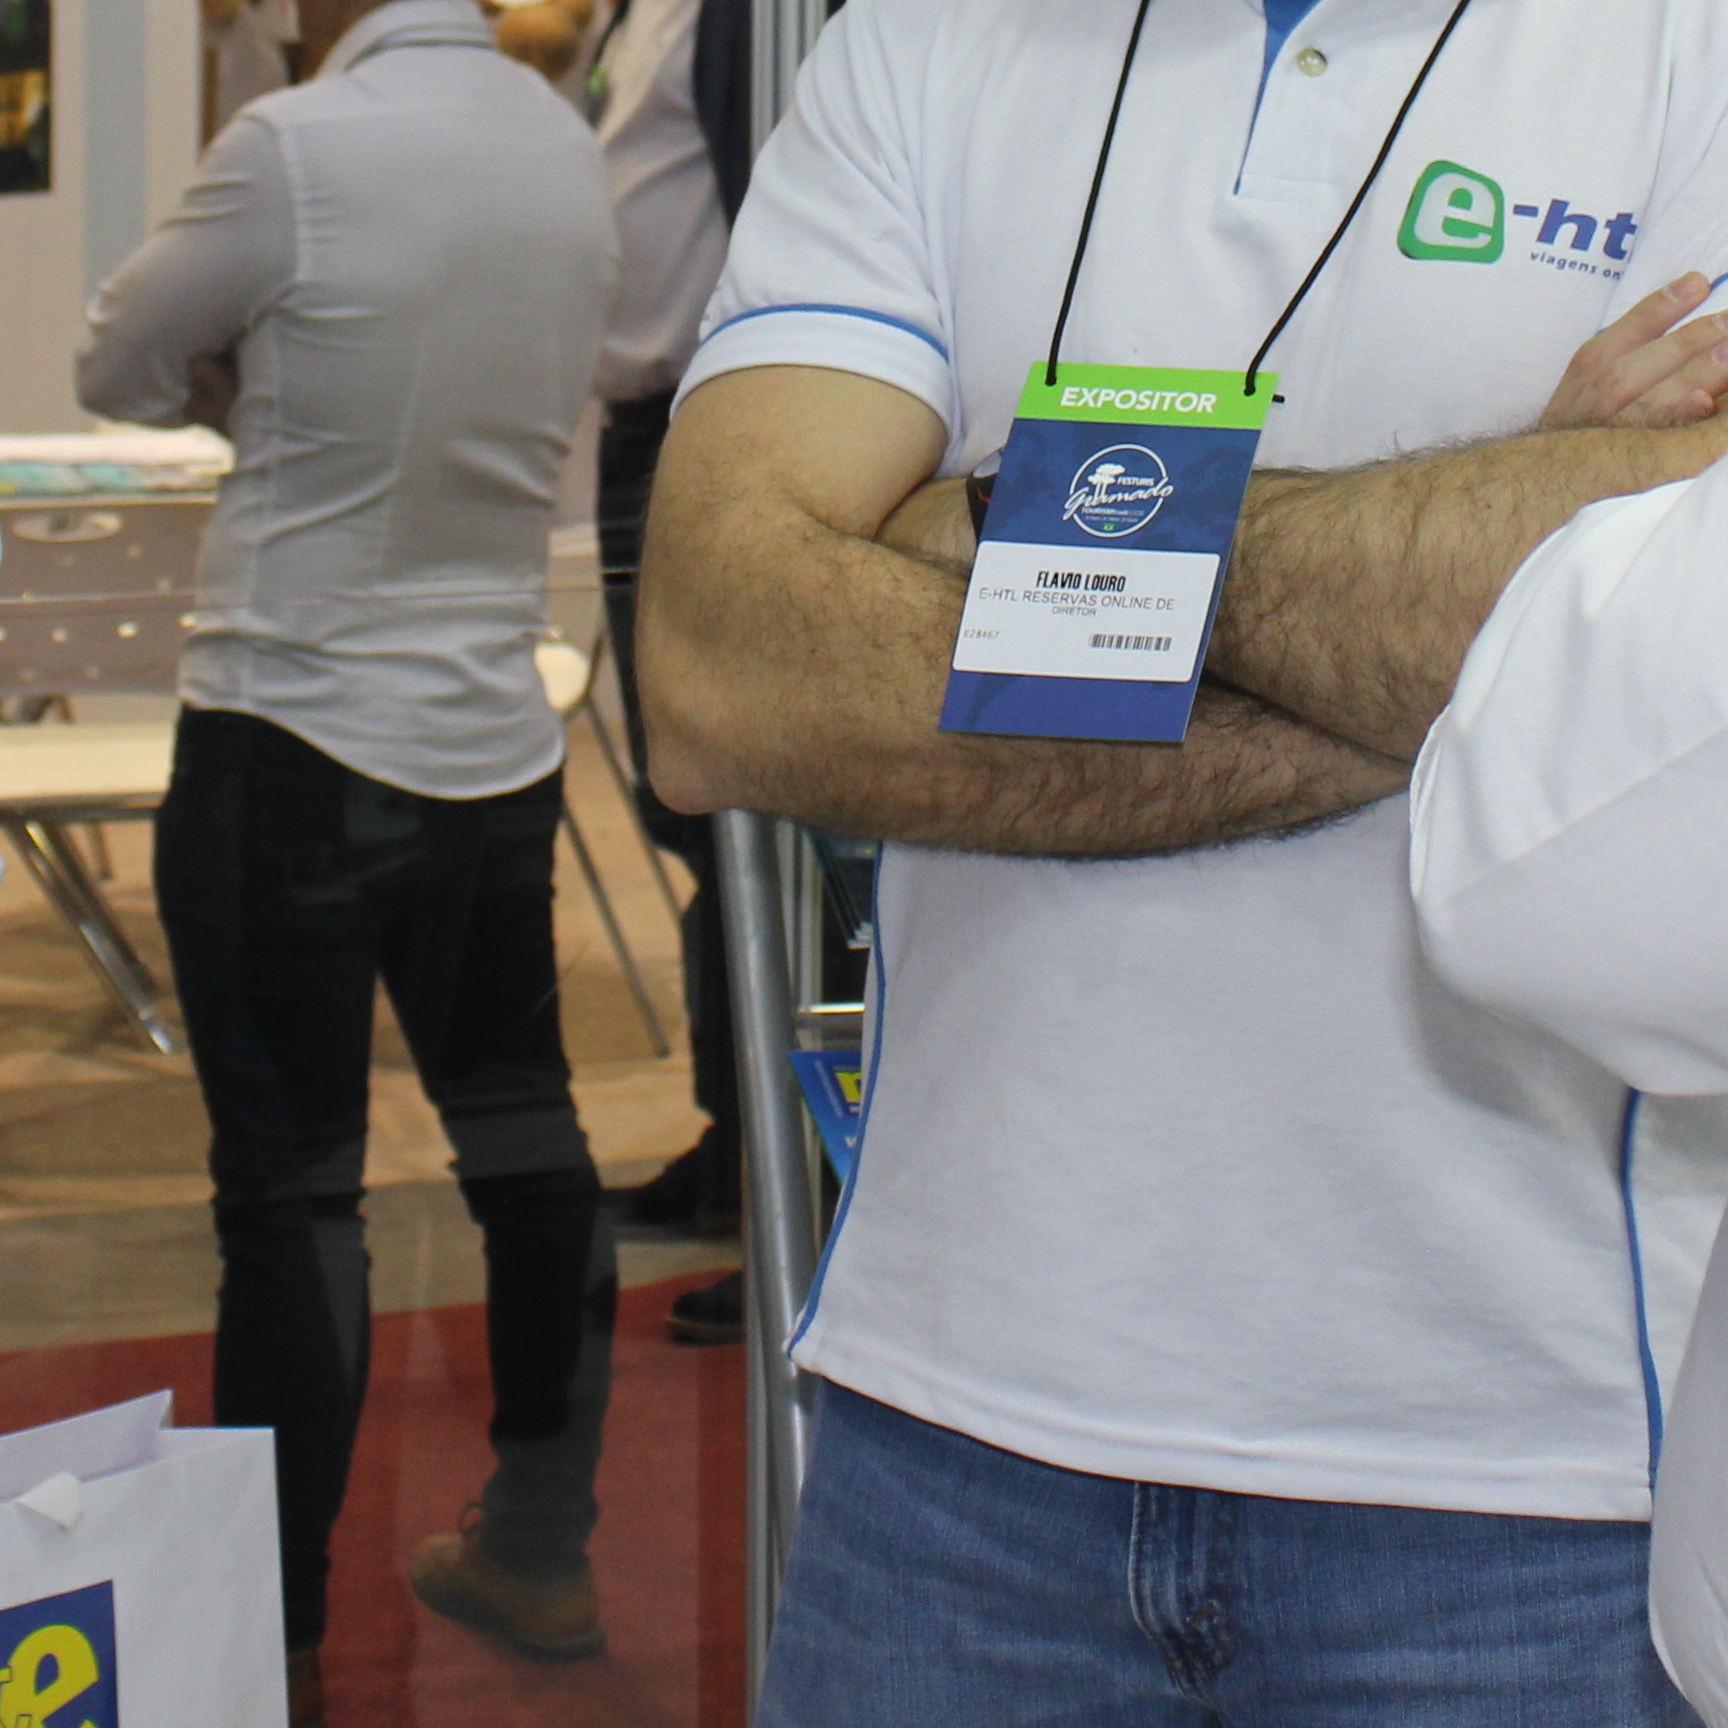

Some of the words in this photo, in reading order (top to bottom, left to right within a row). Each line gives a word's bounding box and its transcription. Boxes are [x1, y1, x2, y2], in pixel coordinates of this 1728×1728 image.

[1530, 251, 1598, 275] viagens
[1060, 386, 1218, 414] EXPOSITOR
[1035, 570, 1082, 590] FLAVIO
[1084, 573, 1127, 593] LOURO
[978, 587, 1018, 602] E-HTL
[1022, 589, 1098, 607] RESERVAS
[1101, 594, 1152, 610] ONLINE
[1156, 598, 1176, 611] DE
[1051, 605, 1098, 617] DIRETOR
